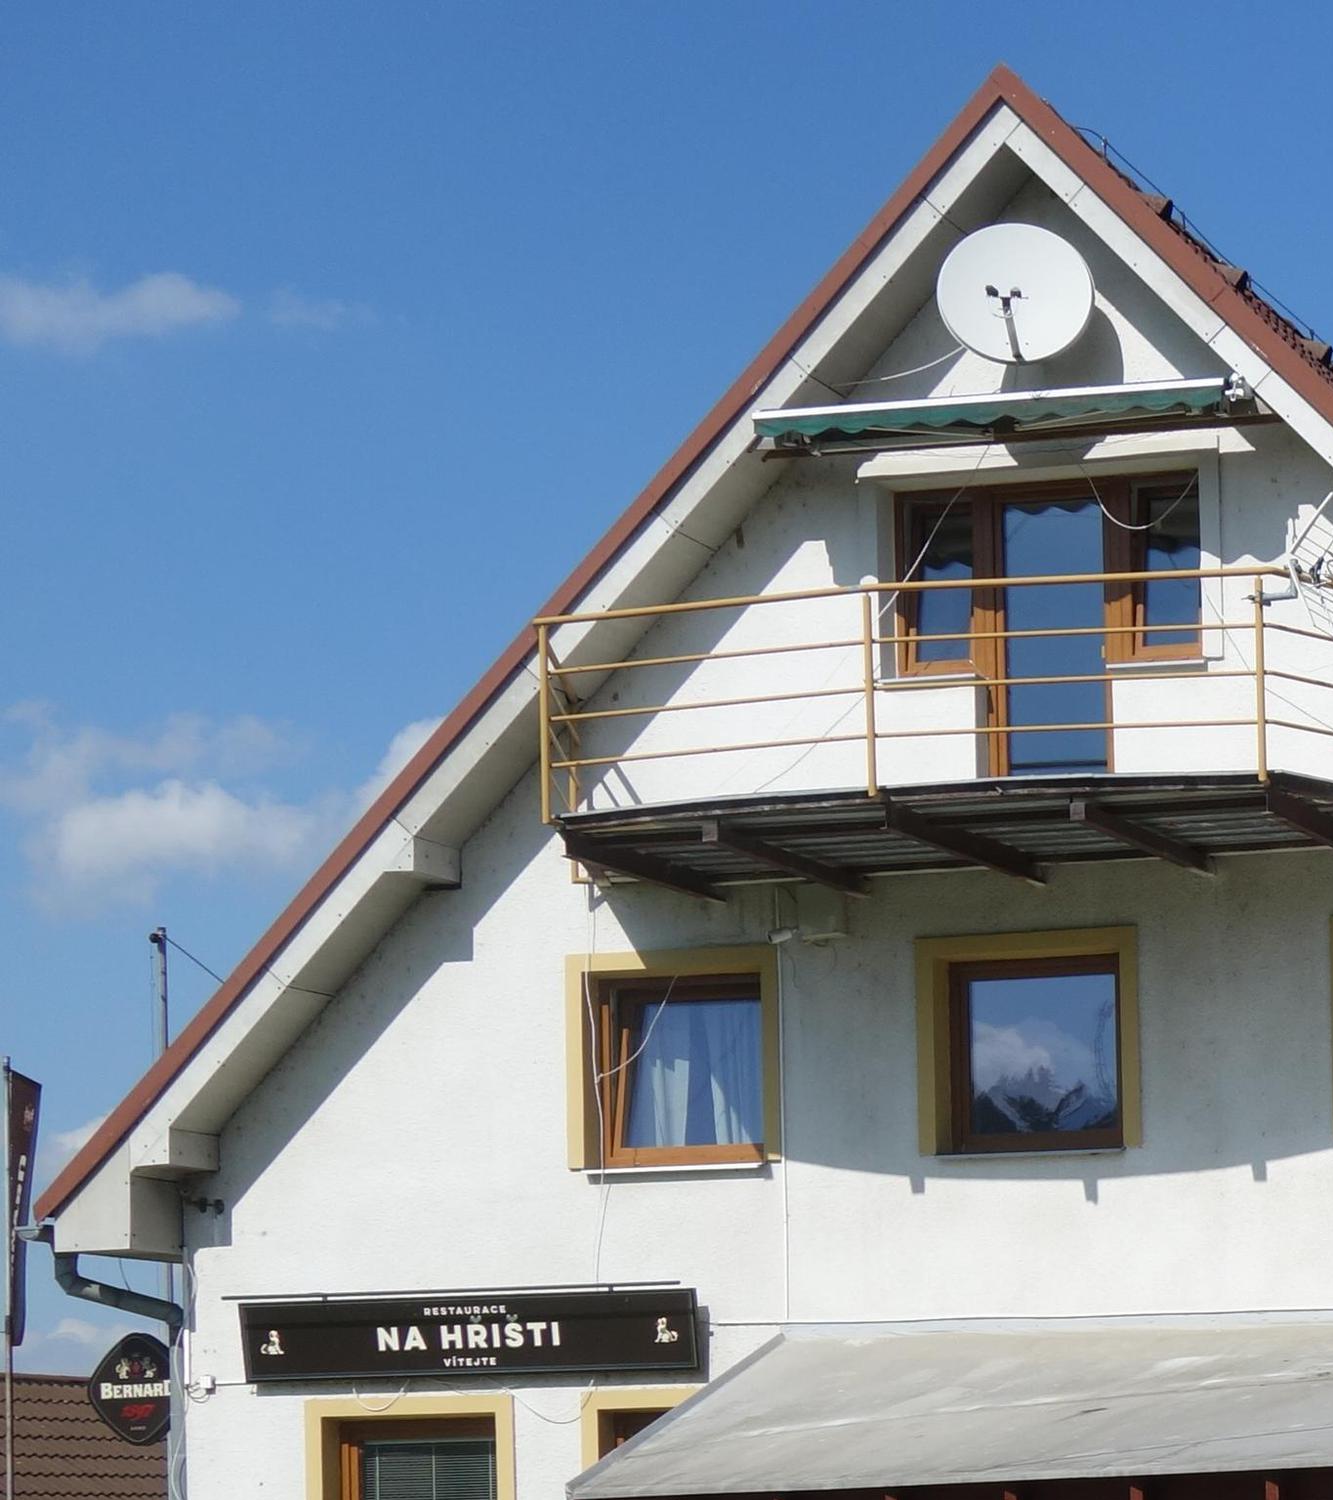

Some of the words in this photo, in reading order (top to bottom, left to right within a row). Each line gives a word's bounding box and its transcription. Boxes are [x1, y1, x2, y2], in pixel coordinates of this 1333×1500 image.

[423, 1305, 507, 1317] RESTAURACE
[376, 1326, 427, 1351] NA
[440, 1314, 561, 1349] HŘIŠTI
[443, 1356, 497, 1367] VÍTEJTE
